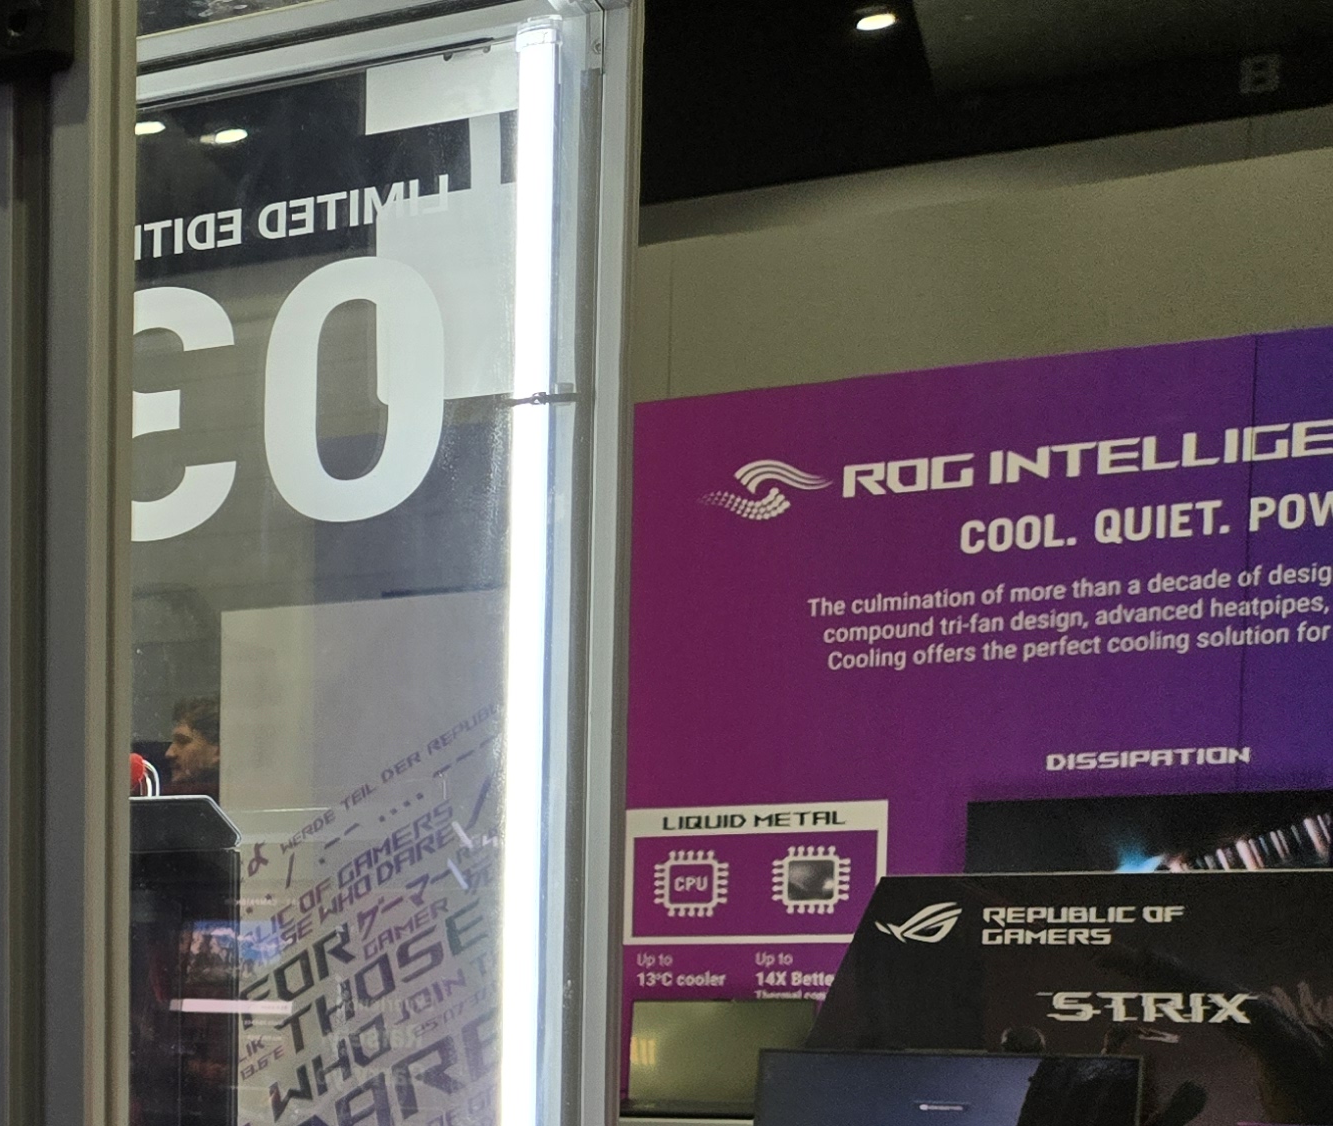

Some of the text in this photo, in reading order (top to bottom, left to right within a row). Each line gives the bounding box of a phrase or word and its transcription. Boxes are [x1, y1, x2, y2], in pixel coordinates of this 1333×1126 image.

[842, 418, 1333, 498] ROG INTELLIGE
[960, 491, 1333, 554] COOL. QUIET. POW
[807, 562, 1333, 618] The culmination of more than a decade of desig
[823, 594, 1330, 647] compound tri-fan design, advanced heatpipes,
[827, 621, 1330, 673] Cooling offers the perfect cooling solution for
[1046, 747, 1252, 771] DISSIPATION
[279, 809, 336, 854] WERDE
[339, 783, 377, 812] TEIL
[380, 750, 422, 784] DER
[662, 810, 847, 831] LIQUID METAL
[299, 876, 332, 914] OF
[337, 800, 454, 889] GAMERS
[319, 873, 372, 925] WHO
[376, 822, 457, 886] DARE
[673, 875, 708, 892] CPU
[364, 897, 449, 961] GAMER
[981, 928, 1112, 946] GAMERS
[982, 905, 1186, 926] REPUBLIC OF
[238, 921, 357, 1031] FOR
[275, 896, 489, 1052] THOSE
[637, 953, 673, 968] Up to
[676, 970, 727, 987] cooler
[755, 952, 793, 968] Up to
[755, 970, 835, 987] 14X Bette
[394, 967, 467, 1027] JOIN
[1036, 990, 1260, 1024] STRIX
[269, 1011, 393, 1124] WHO
